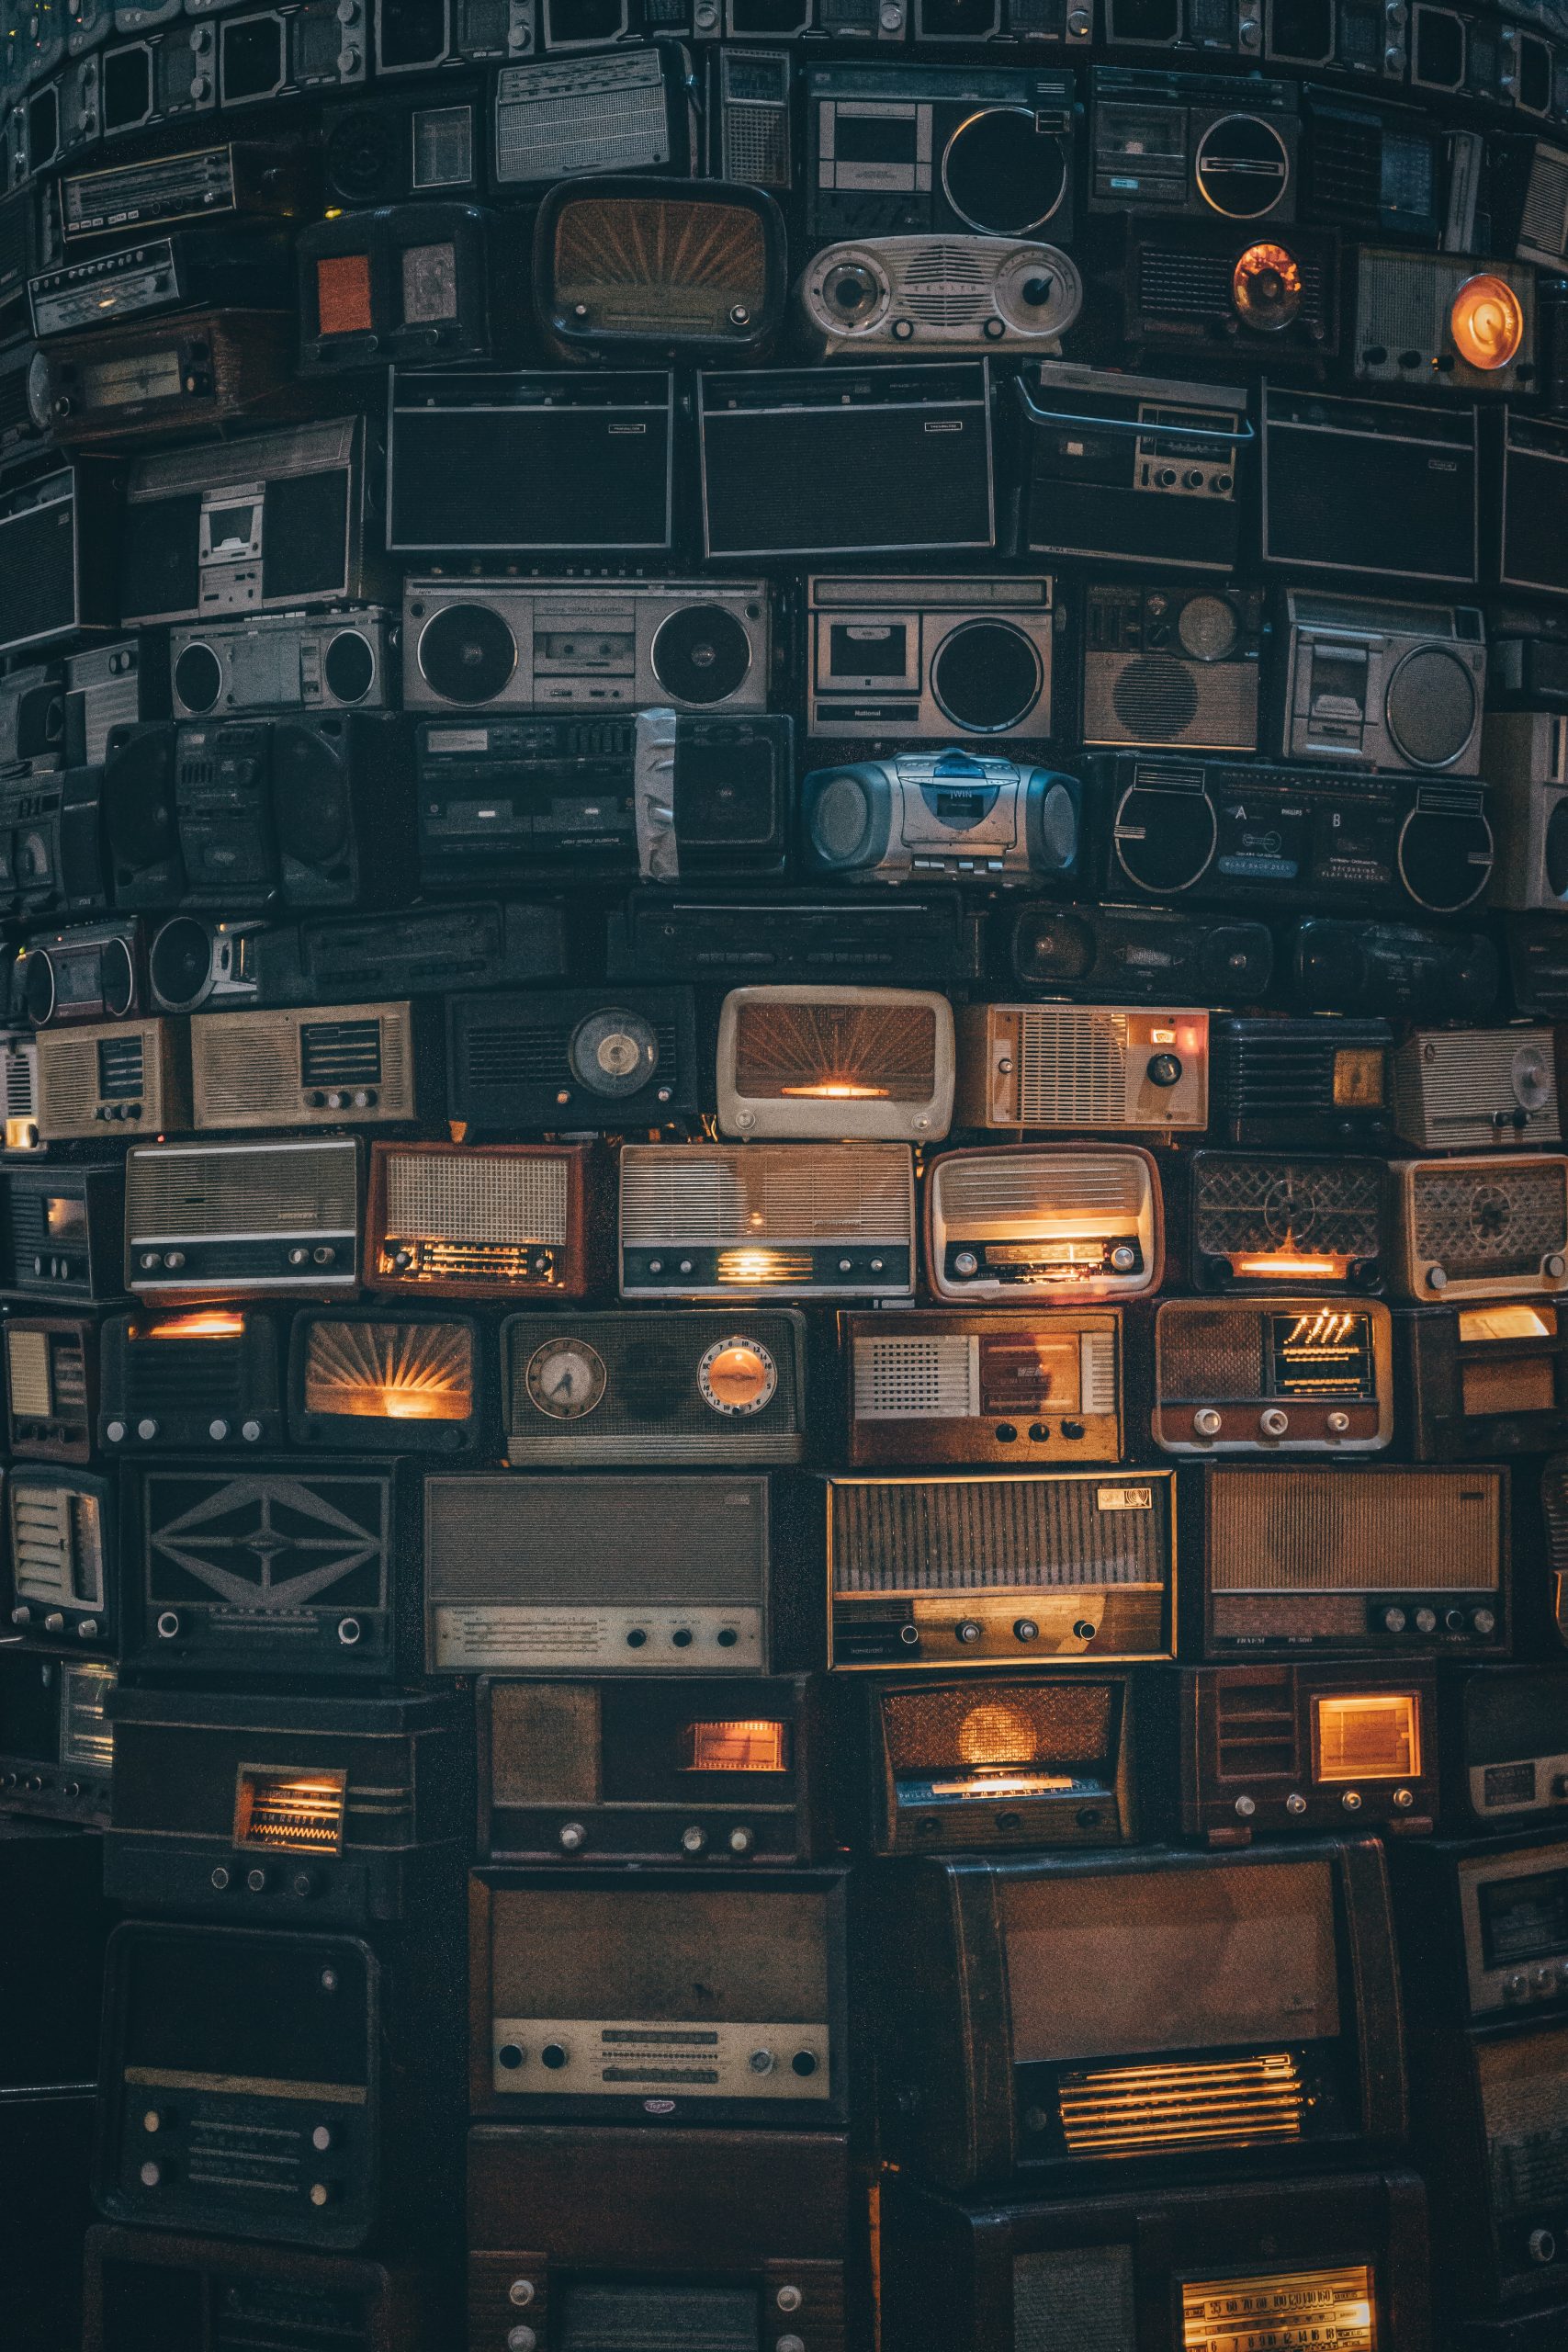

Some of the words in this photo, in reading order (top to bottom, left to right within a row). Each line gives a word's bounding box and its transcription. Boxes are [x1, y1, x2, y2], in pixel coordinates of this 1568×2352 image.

[1235, 806, 1247, 820] A
[1281, 808, 1303, 817] PHILIPS
[1332, 813, 1341, 828] B
[1210, 2302, 1221, 2314] 55
[1226, 2301, 1237, 2312] 60
[1242, 2299, 1252, 2310] 70
[1257, 2297, 1267, 2309] 80
[1273, 2294, 1286, 2307] 100
[1288, 2292, 1302, 2306] 120
[1303, 2290, 1316, 2304] 140
[1317, 2290, 1331, 2303] 160
[1211, 2340, 1217, 2352] 6
[1233, 2337, 1238, 2350] 7
[1268, 2334, 1276, 2346] 10
[1283, 2332, 1292, 2344] 12
[1298, 2330, 1307, 2343] 14
[1311, 2329, 1320, 2341] 16
[1325, 2327, 1335, 2340] 18
